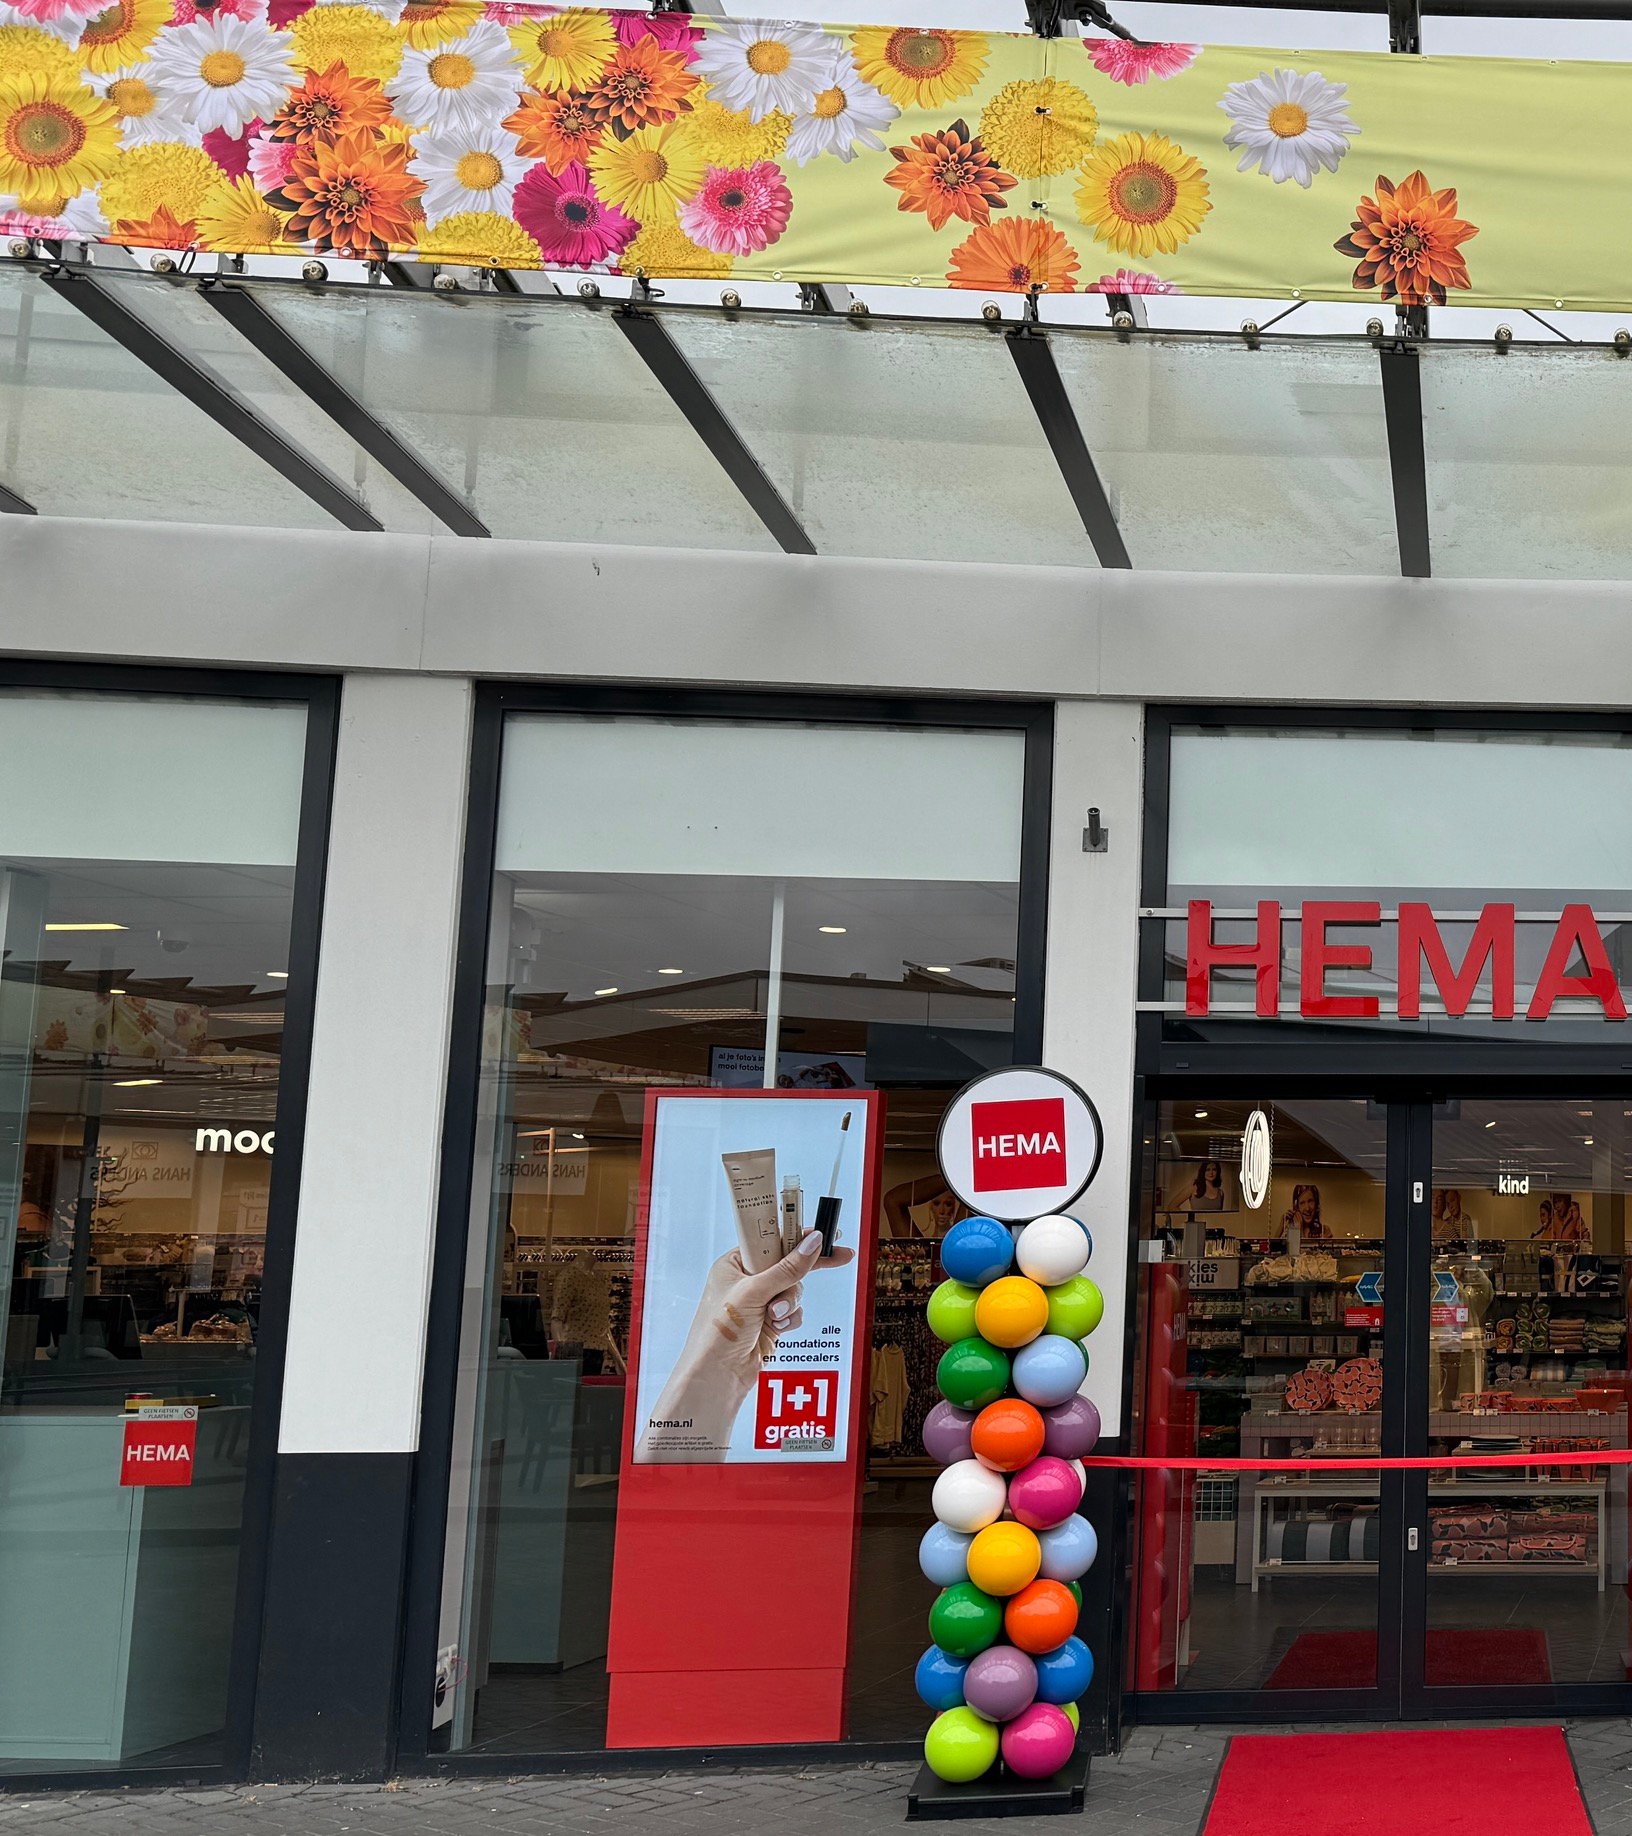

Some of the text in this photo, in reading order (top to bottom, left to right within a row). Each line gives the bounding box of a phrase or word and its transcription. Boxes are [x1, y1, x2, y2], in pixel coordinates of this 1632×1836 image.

[1184, 899, 1629, 1020] HEMA
[978, 1132, 1061, 1159] HEMA
[1498, 1174, 1529, 1195] kind
[1188, 1260, 1219, 1273] kies
[821, 1325, 841, 1335] alle
[774, 1339, 841, 1349] foundations
[762, 1353, 840, 1363] en concealers
[767, 1379, 829, 1417] 1+1
[649, 1418, 693, 1428] hema.nl
[764, 1421, 826, 1444] gratis
[126, 1444, 191, 1461] HEMA
